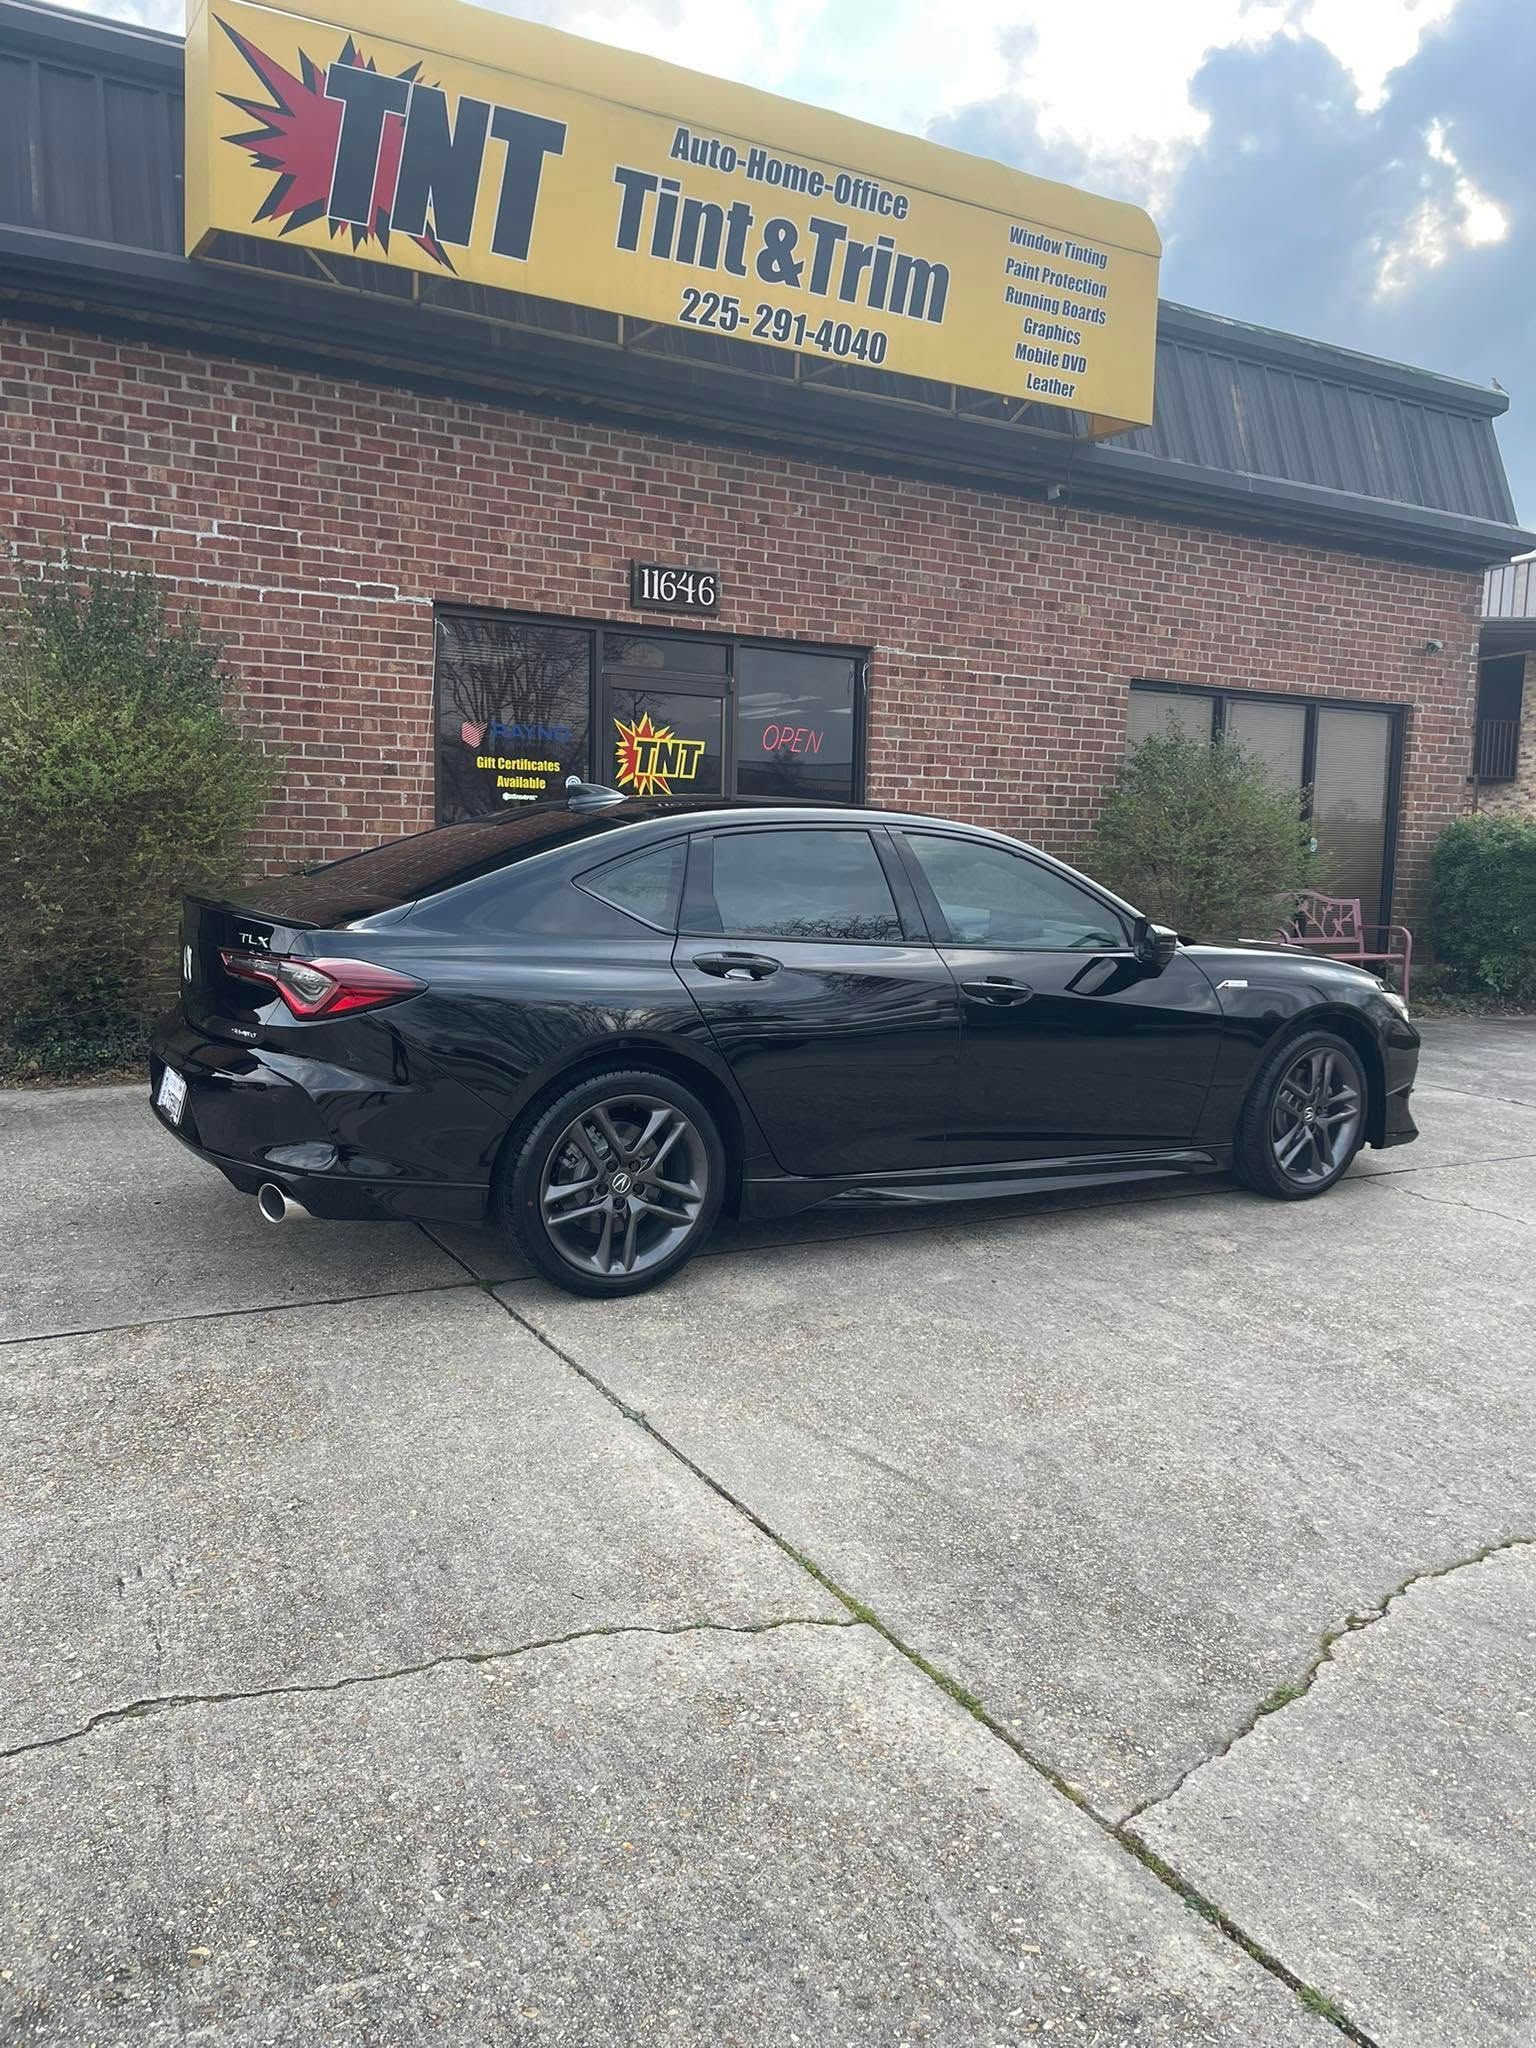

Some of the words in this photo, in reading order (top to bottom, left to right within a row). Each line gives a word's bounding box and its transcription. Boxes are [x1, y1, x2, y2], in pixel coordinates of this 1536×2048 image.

[324, 62, 567, 262] TNT
[670, 127, 909, 221] Auto-Home-Office
[1009, 225, 1062, 255] Window
[1064, 240, 1108, 270] Tinting
[1005, 258, 1040, 282] Paint
[1041, 266, 1107, 298] Protection
[1005, 286, 1060, 315] Running
[1061, 300, 1106, 324] Boards
[1023, 317, 1081, 345] Graphics
[1015, 343, 1059, 367] Mobile
[1061, 353, 1087, 373] DVD
[1026, 373, 1075, 397] Leather
[641, 568, 715, 606] 11646
[762, 725, 824, 754] OPEN
[476, 756, 496, 769] Gift
[497, 757, 560, 772] Certificates
[633, 737, 705, 779] TNT
[496, 775, 546, 789] Available
[239, 932, 269, 948] TLX
